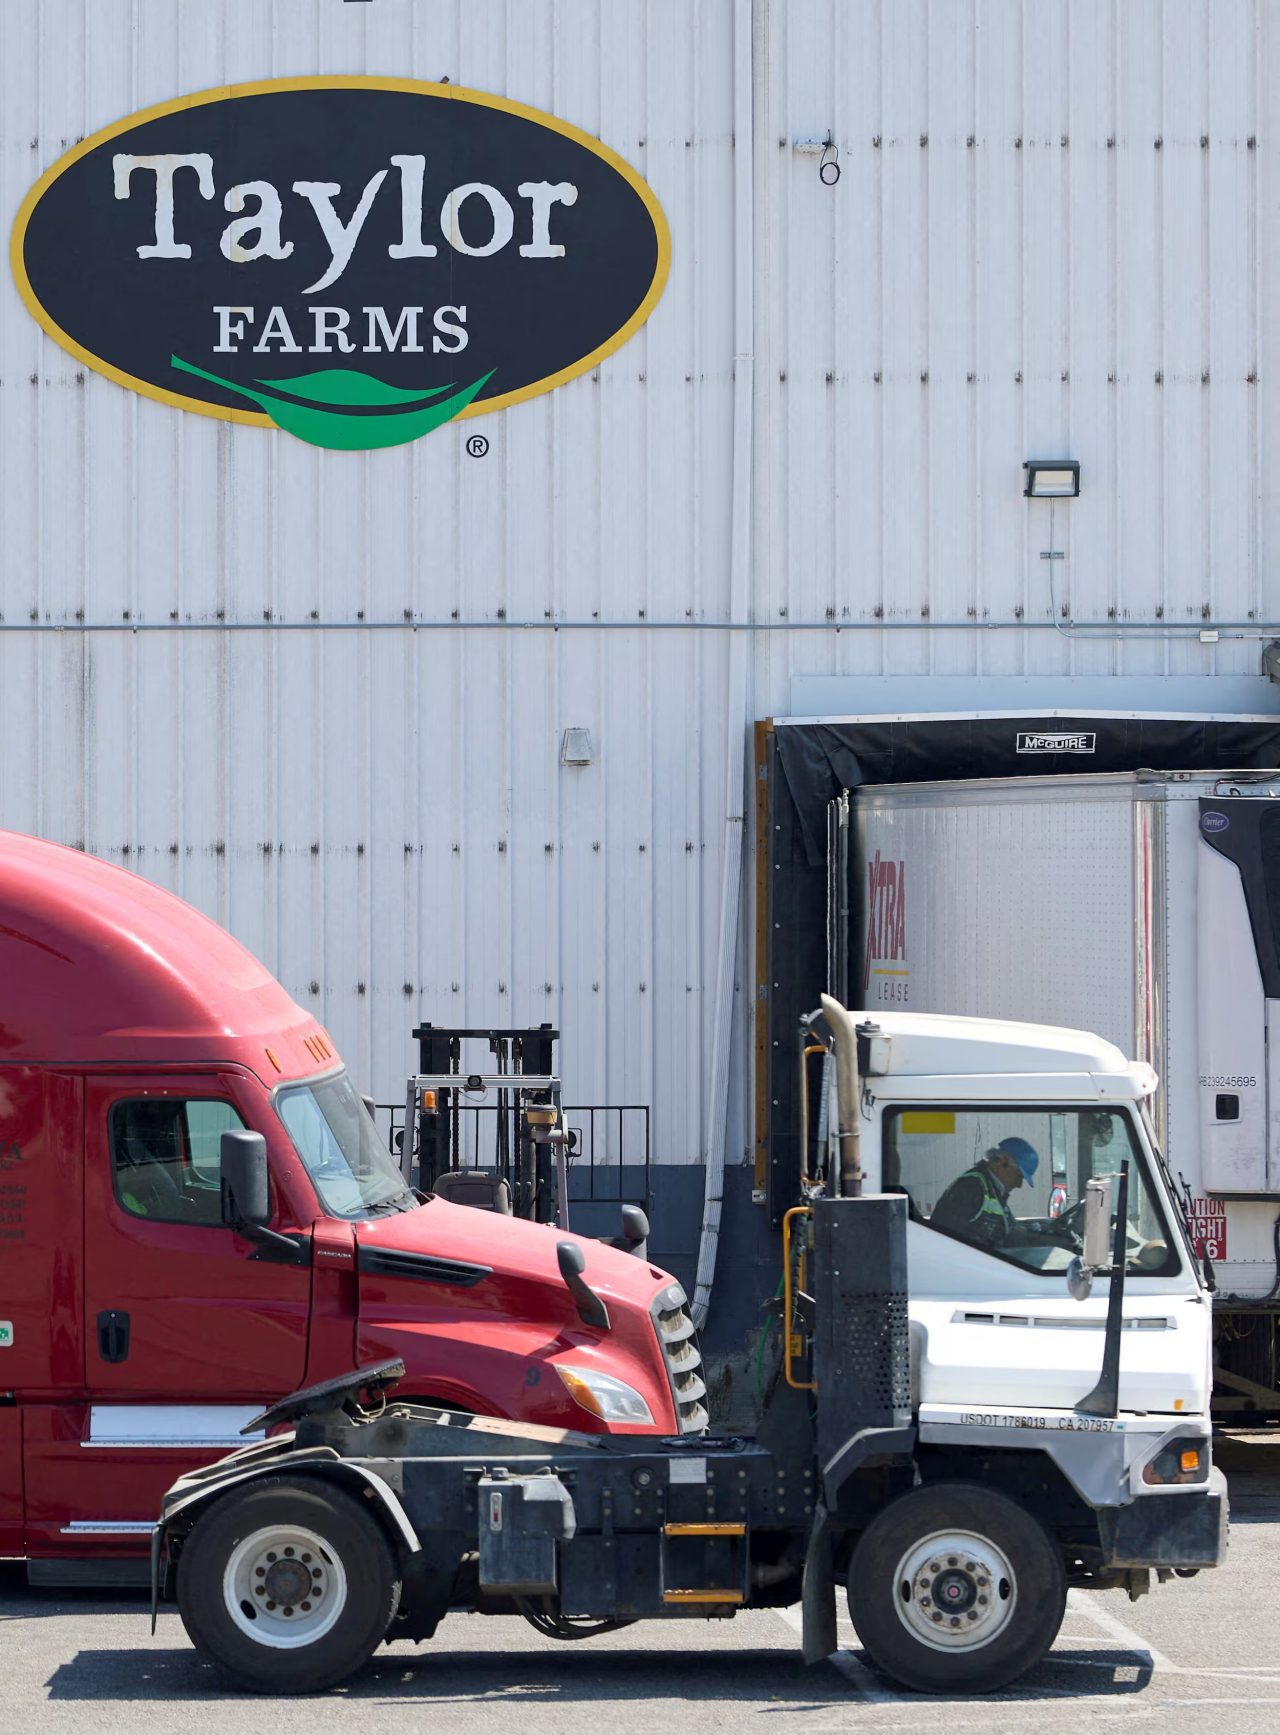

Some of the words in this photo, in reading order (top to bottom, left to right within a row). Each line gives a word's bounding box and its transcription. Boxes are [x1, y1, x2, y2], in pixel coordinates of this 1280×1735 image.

[112, 152, 579, 294] Taylor
[212, 304, 470, 355] FARMS
[1024, 735, 1087, 749] McGUIRE
[864, 849, 905, 990] XTRA
[878, 982, 909, 1002] LEASE
[1183, 1200, 1224, 1216] AUTION
[960, 1413, 999, 1426] USDOT
[1058, 1417, 1074, 1430] CA
[1078, 1419, 1114, 1432] 207957
